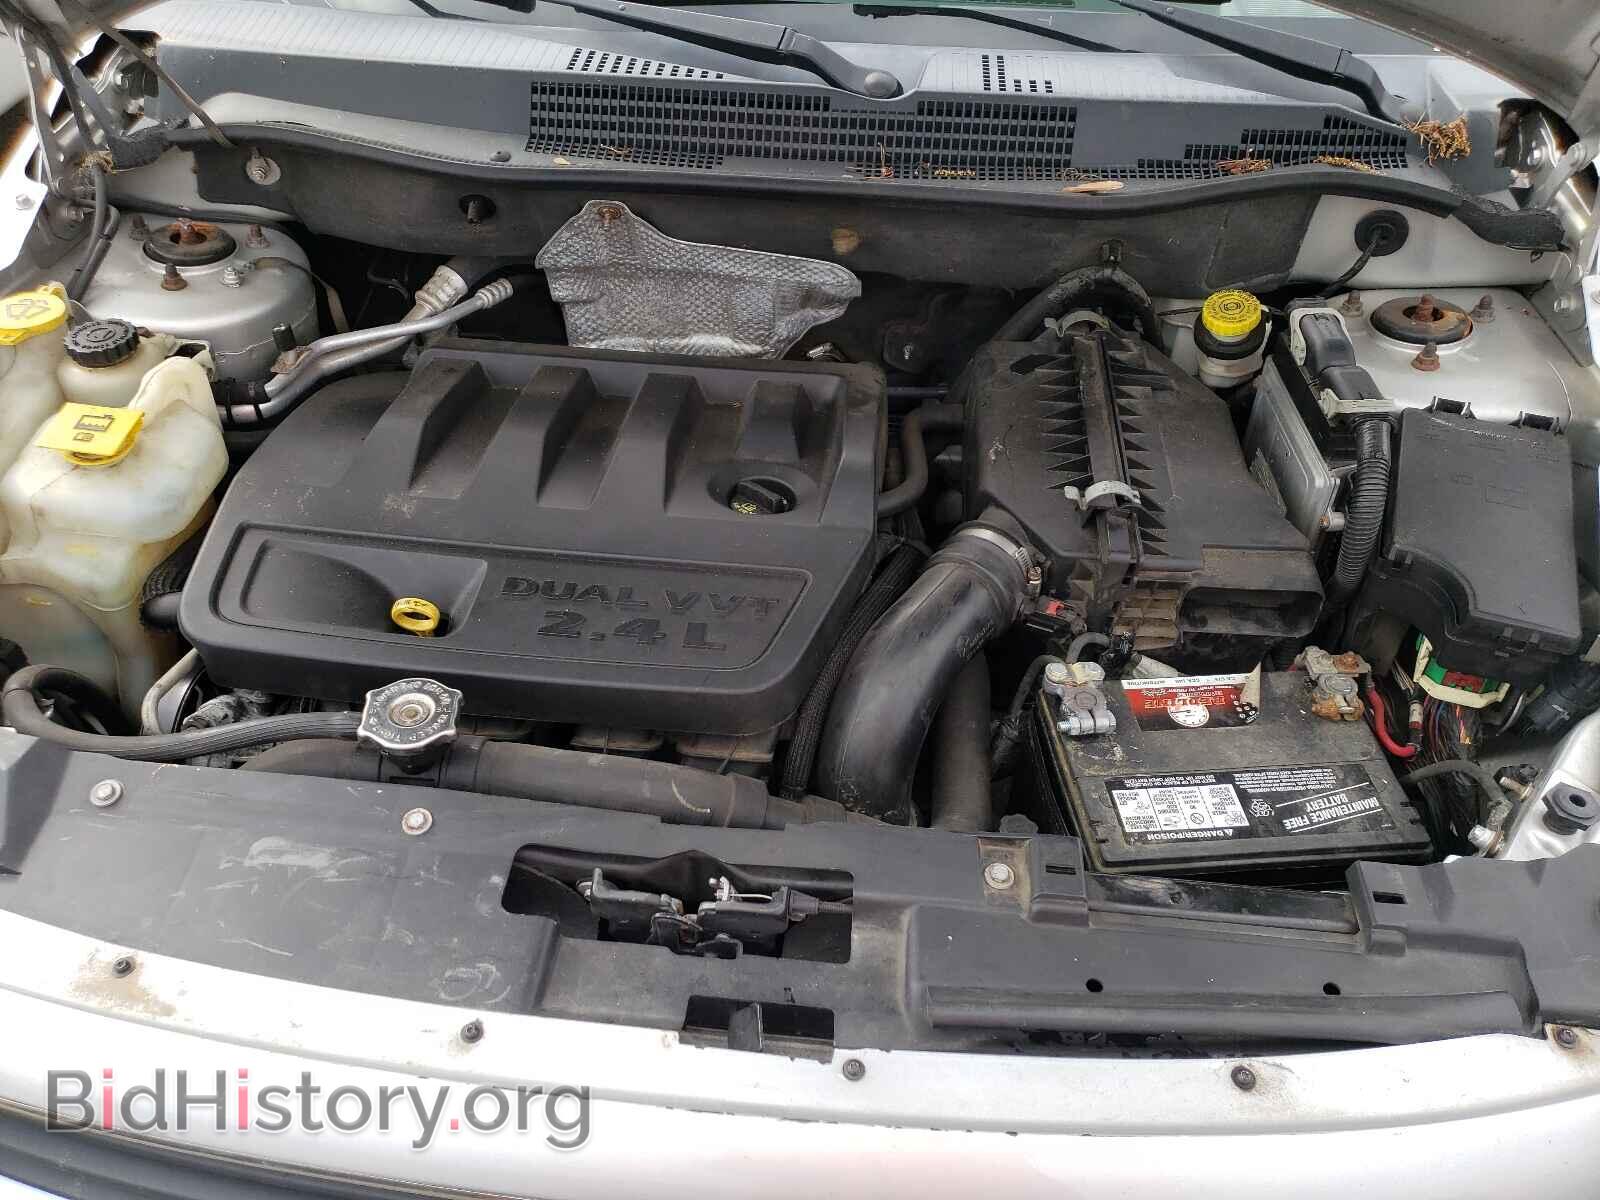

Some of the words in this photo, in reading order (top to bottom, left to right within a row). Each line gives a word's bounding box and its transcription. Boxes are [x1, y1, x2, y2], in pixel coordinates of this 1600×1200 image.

[500, 575, 649, 607] DUAL
[664, 589, 780, 615] VVT
[1304, 793, 1349, 813] BATTERY
[1311, 796, 1380, 823] MAINTENANCE
[1282, 817, 1310, 830] FREE
[1147, 829, 1223, 841] DANGER/POISON
